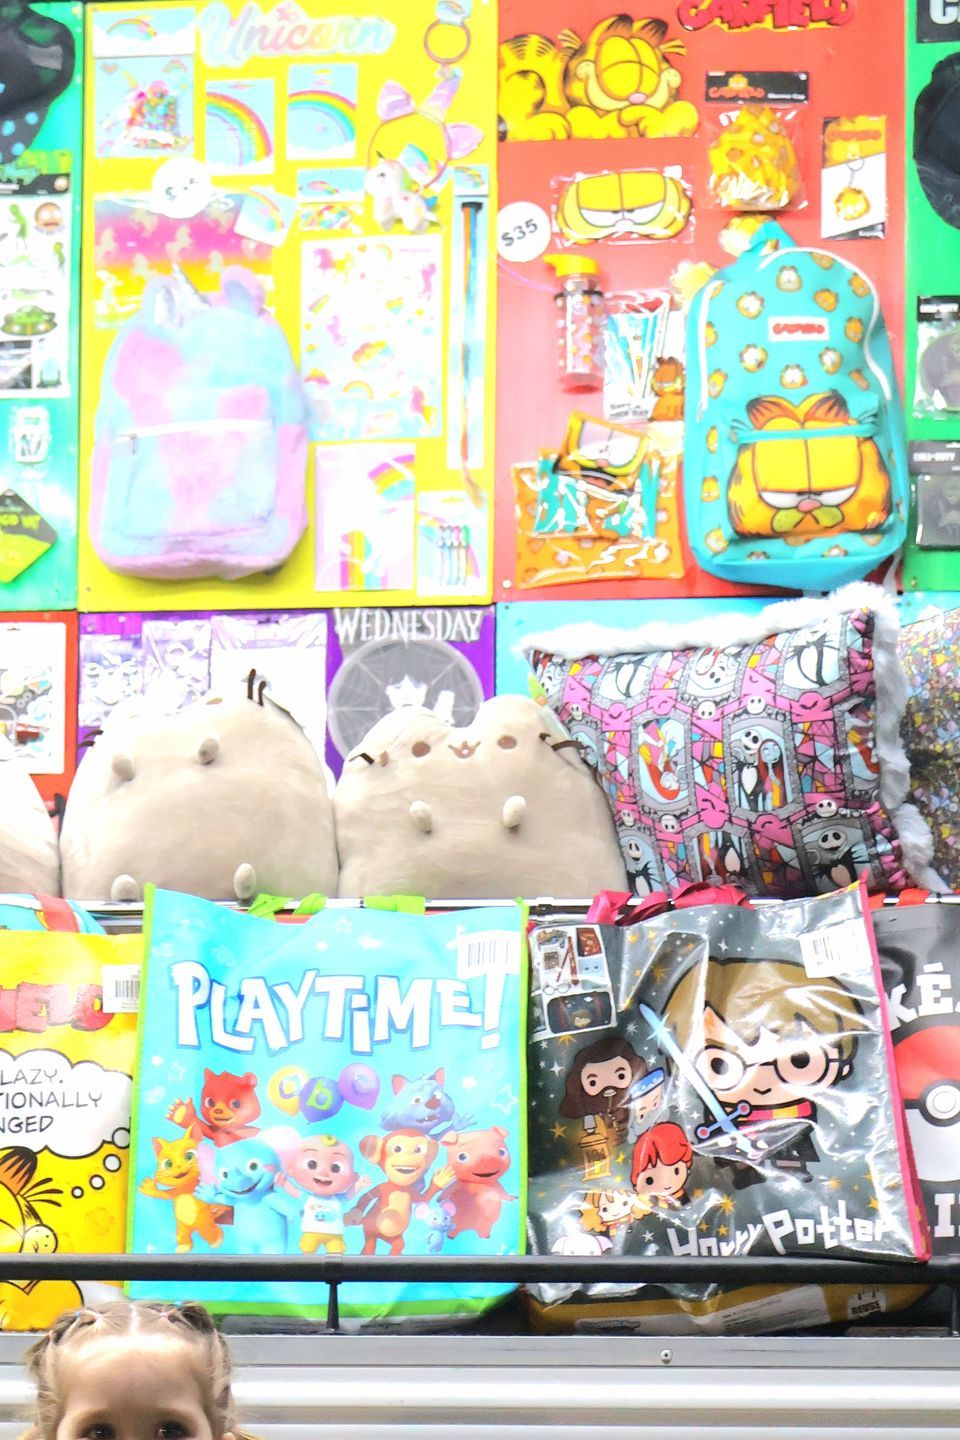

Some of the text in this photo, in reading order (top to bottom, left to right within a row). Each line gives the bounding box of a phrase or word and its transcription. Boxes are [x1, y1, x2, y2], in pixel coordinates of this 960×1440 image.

[202, 6, 387, 62] Unicorn
[500, 217, 539, 247] $35
[333, 608, 484, 644] WEDNESDAY
[0, 1068, 65, 1086] LAZY.
